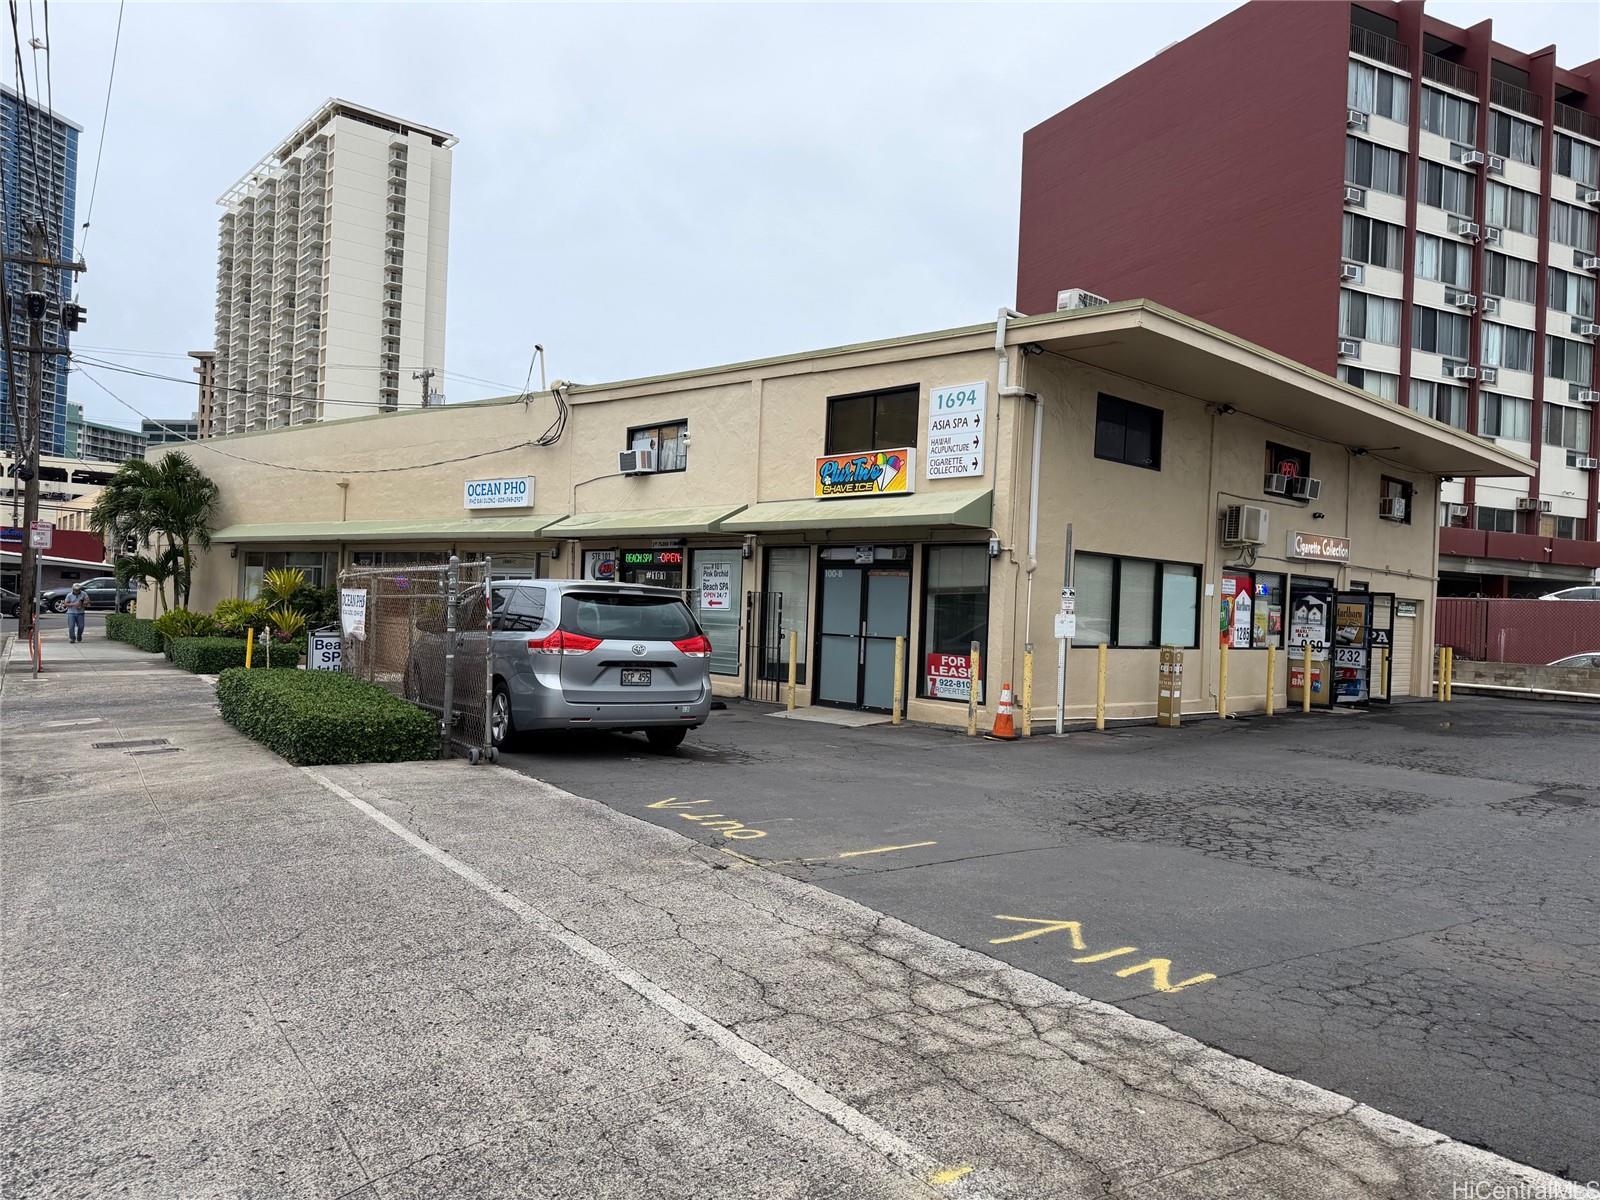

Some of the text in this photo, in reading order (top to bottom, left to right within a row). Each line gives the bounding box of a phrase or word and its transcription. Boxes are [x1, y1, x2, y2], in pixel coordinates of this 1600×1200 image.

[937, 389, 977, 410] 1694
[931, 417, 969, 431] ASIA SPA
[931, 437, 952, 447] HAWAII
[930, 443, 970, 455] ACUPUNCTURE
[930, 456, 963, 467] CIGARETTE
[820, 457, 884, 484] Plus Two
[929, 464, 969, 475] COLLECTION
[467, 480, 526, 497] OCEAN PHO
[823, 482, 874, 494] SHAVE ICE
[1295, 535, 1348, 558] Cigarette Collection
[592, 552, 611, 560] STE 101
[626, 553, 653, 563] BEACH SPA
[660, 552, 681, 563] OPEN
[646, 570, 666, 580] #101
[702, 582, 729, 591] Beach SPA
[1236, 627, 1250, 641] 1285
[321, 651, 343, 662] SP
[941, 655, 966, 667] FOR
[1335, 649, 1361, 663] 1232
[939, 678, 971, 689] 922-810
[933, 686, 971, 697] ROPERTIES
[678, 812, 767, 840] OUT
